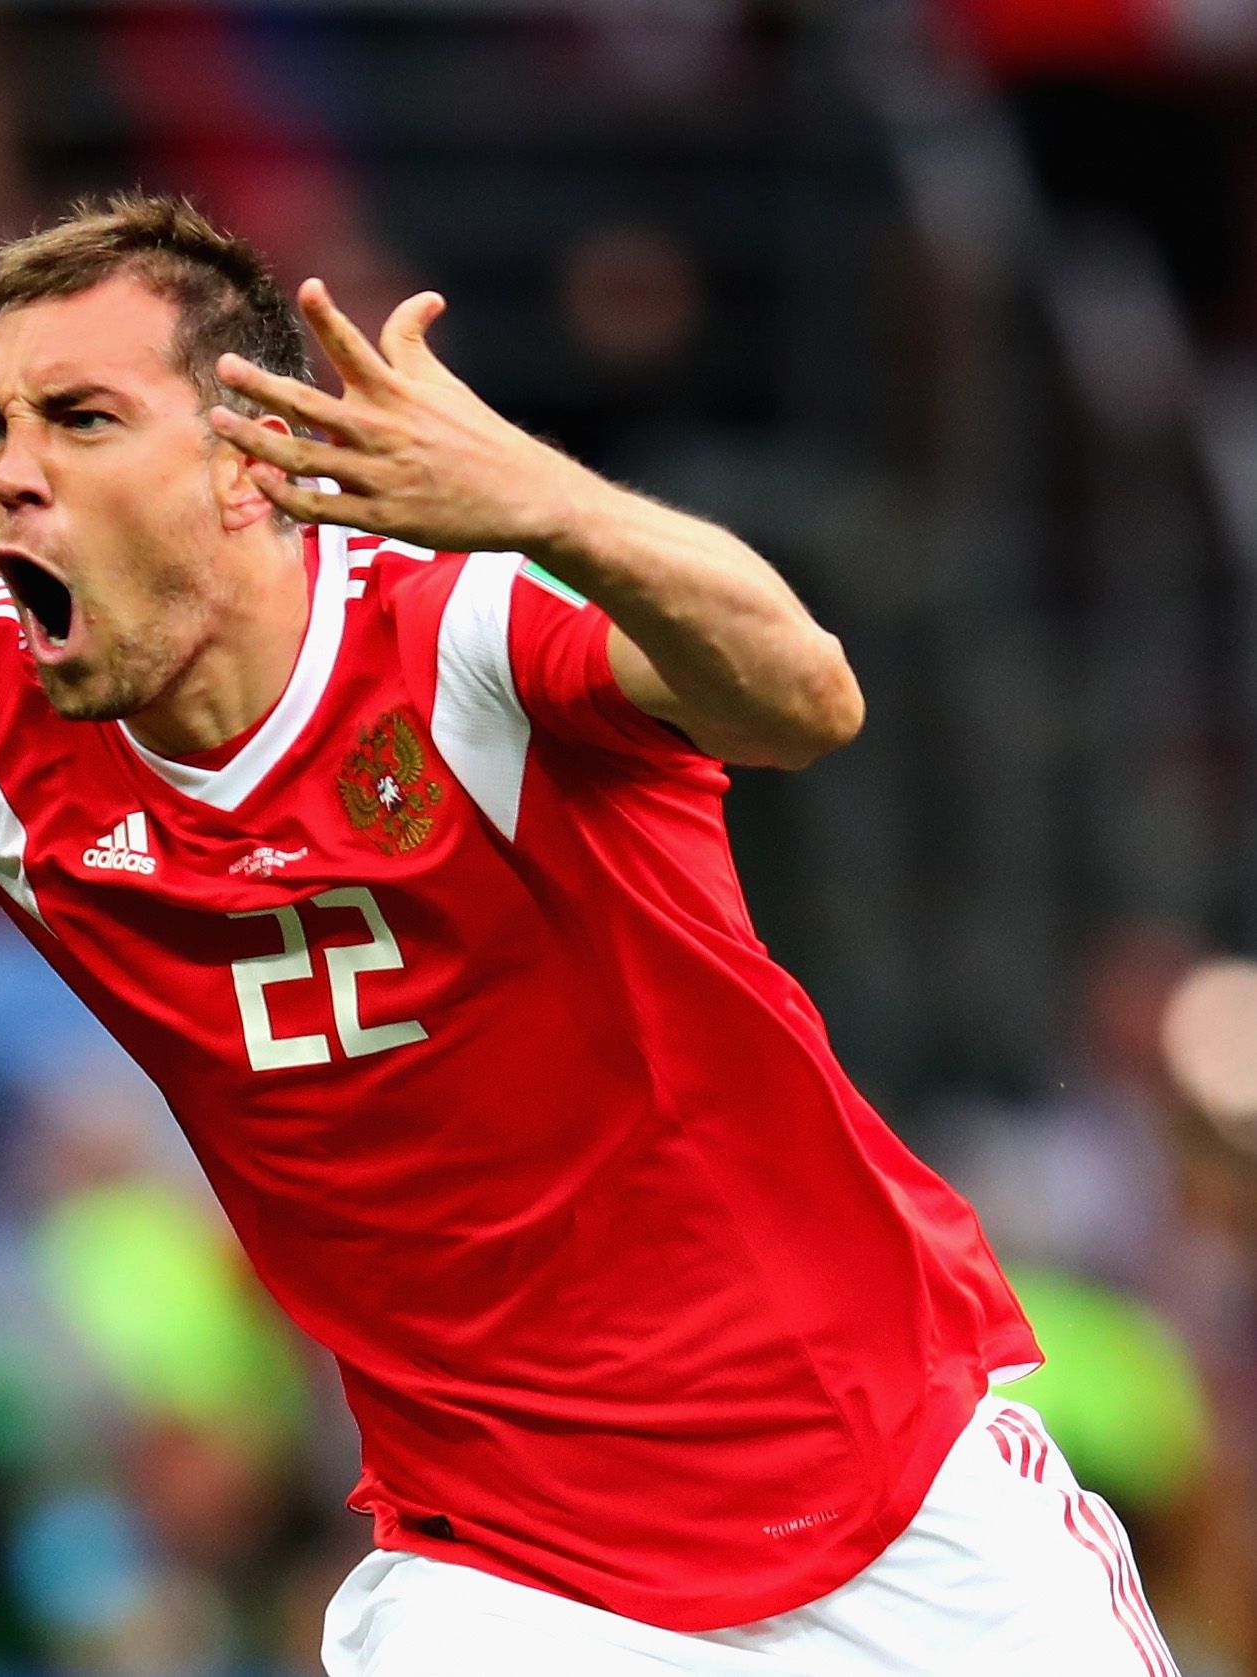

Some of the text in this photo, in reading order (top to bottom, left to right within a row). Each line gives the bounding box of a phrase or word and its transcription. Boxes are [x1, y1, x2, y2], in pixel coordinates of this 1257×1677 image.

[82, 847, 157, 875] adidas
[226, 886, 429, 1071] 22
[771, 1509, 839, 1537] CLIMACHILL
